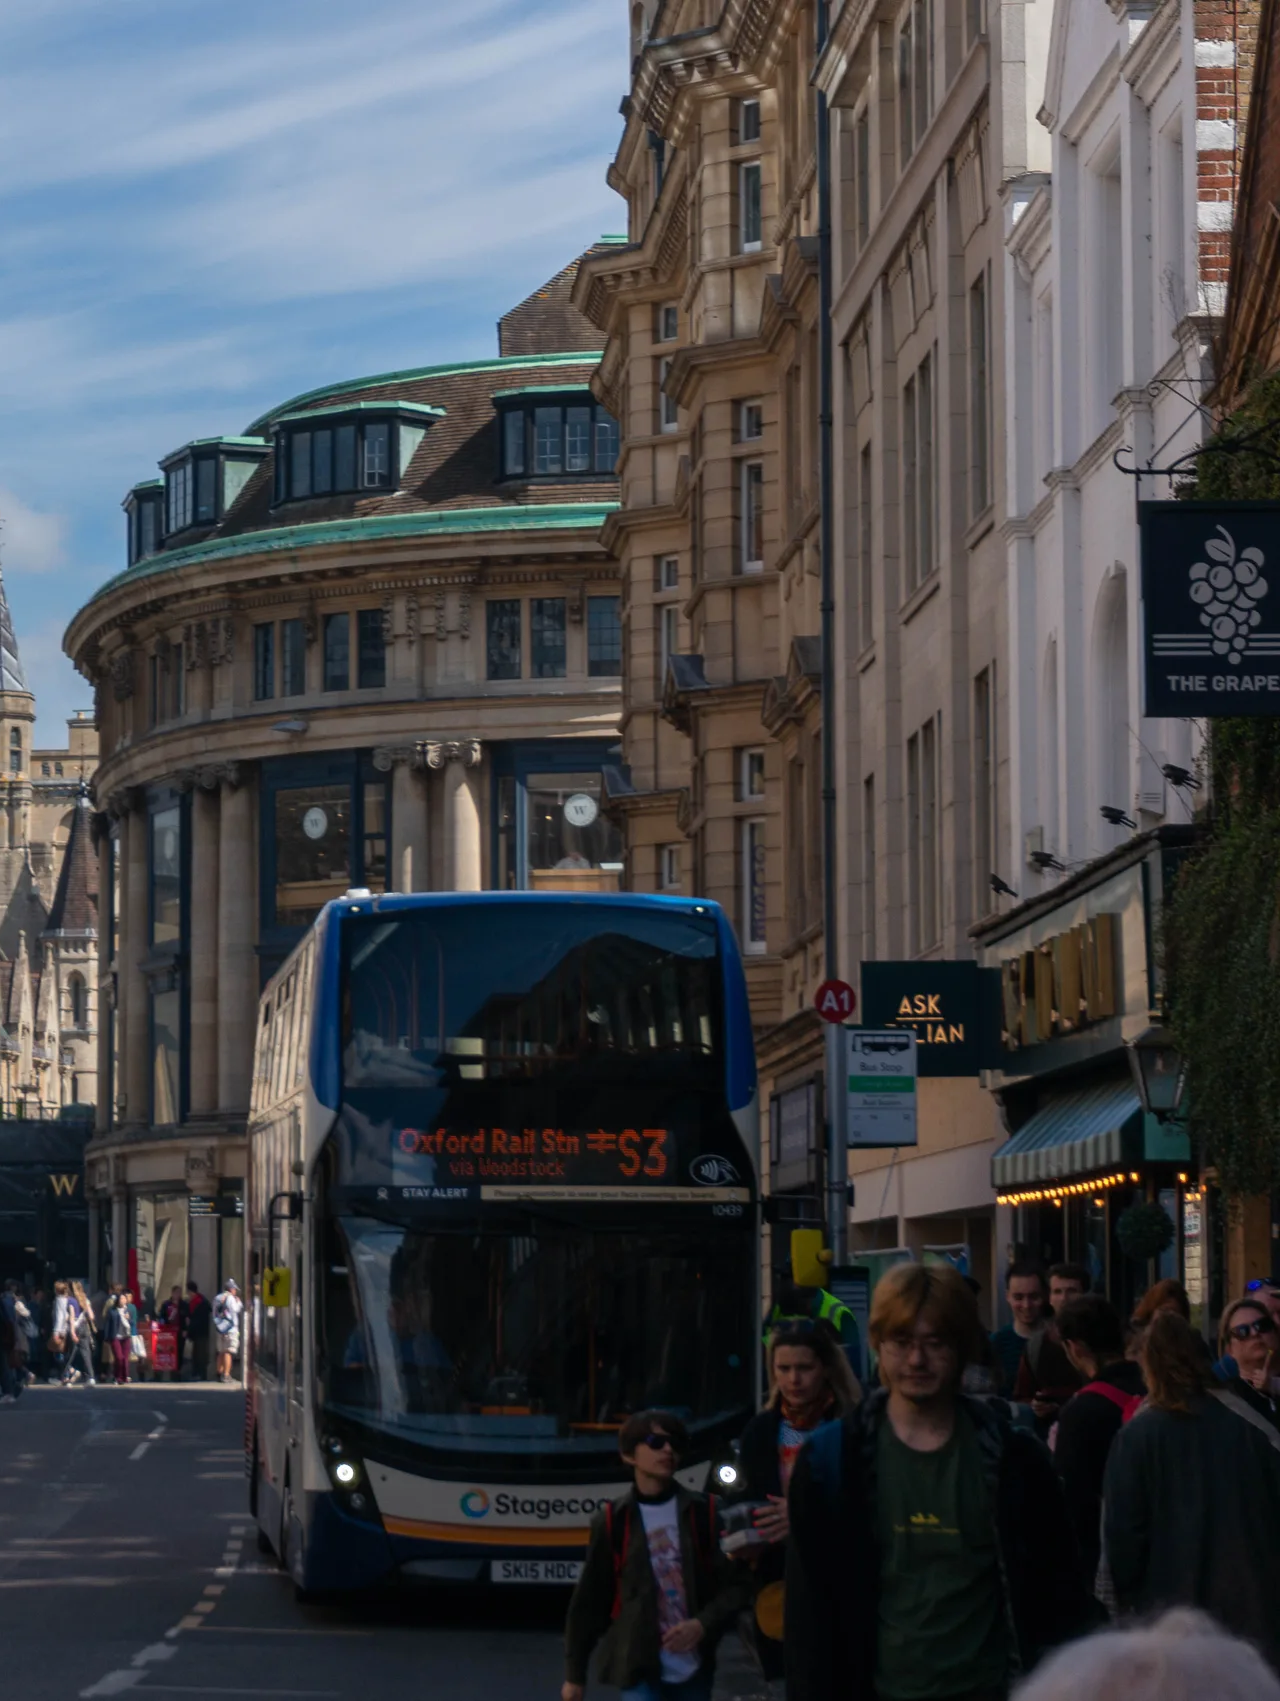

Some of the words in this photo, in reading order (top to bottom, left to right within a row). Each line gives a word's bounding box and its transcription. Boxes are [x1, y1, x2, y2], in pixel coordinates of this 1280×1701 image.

[1166, 675, 1208, 692] THE
[572, 806, 588, 816] W
[822, 989, 851, 1012] A1
[898, 994, 942, 1015] ASK
[859, 1061, 878, 1073] Bus
[880, 1061, 904, 1073] Stop
[399, 1127, 485, 1155] Oxford
[491, 1127, 536, 1155] Rail
[541, 1127, 581, 1155] Stn
[618, 1128, 669, 1177] S3
[449, 1158, 475, 1177] via
[479, 1157, 566, 1177] Woodstock
[48, 1174, 79, 1197] W
[402, 1188, 429, 1198] STAY
[431, 1188, 469, 1198] ALERT
[495, 1493, 613, 1520] Stageco
[502, 1562, 540, 1580] SK15
[544, 1562, 578, 1580] HDC
